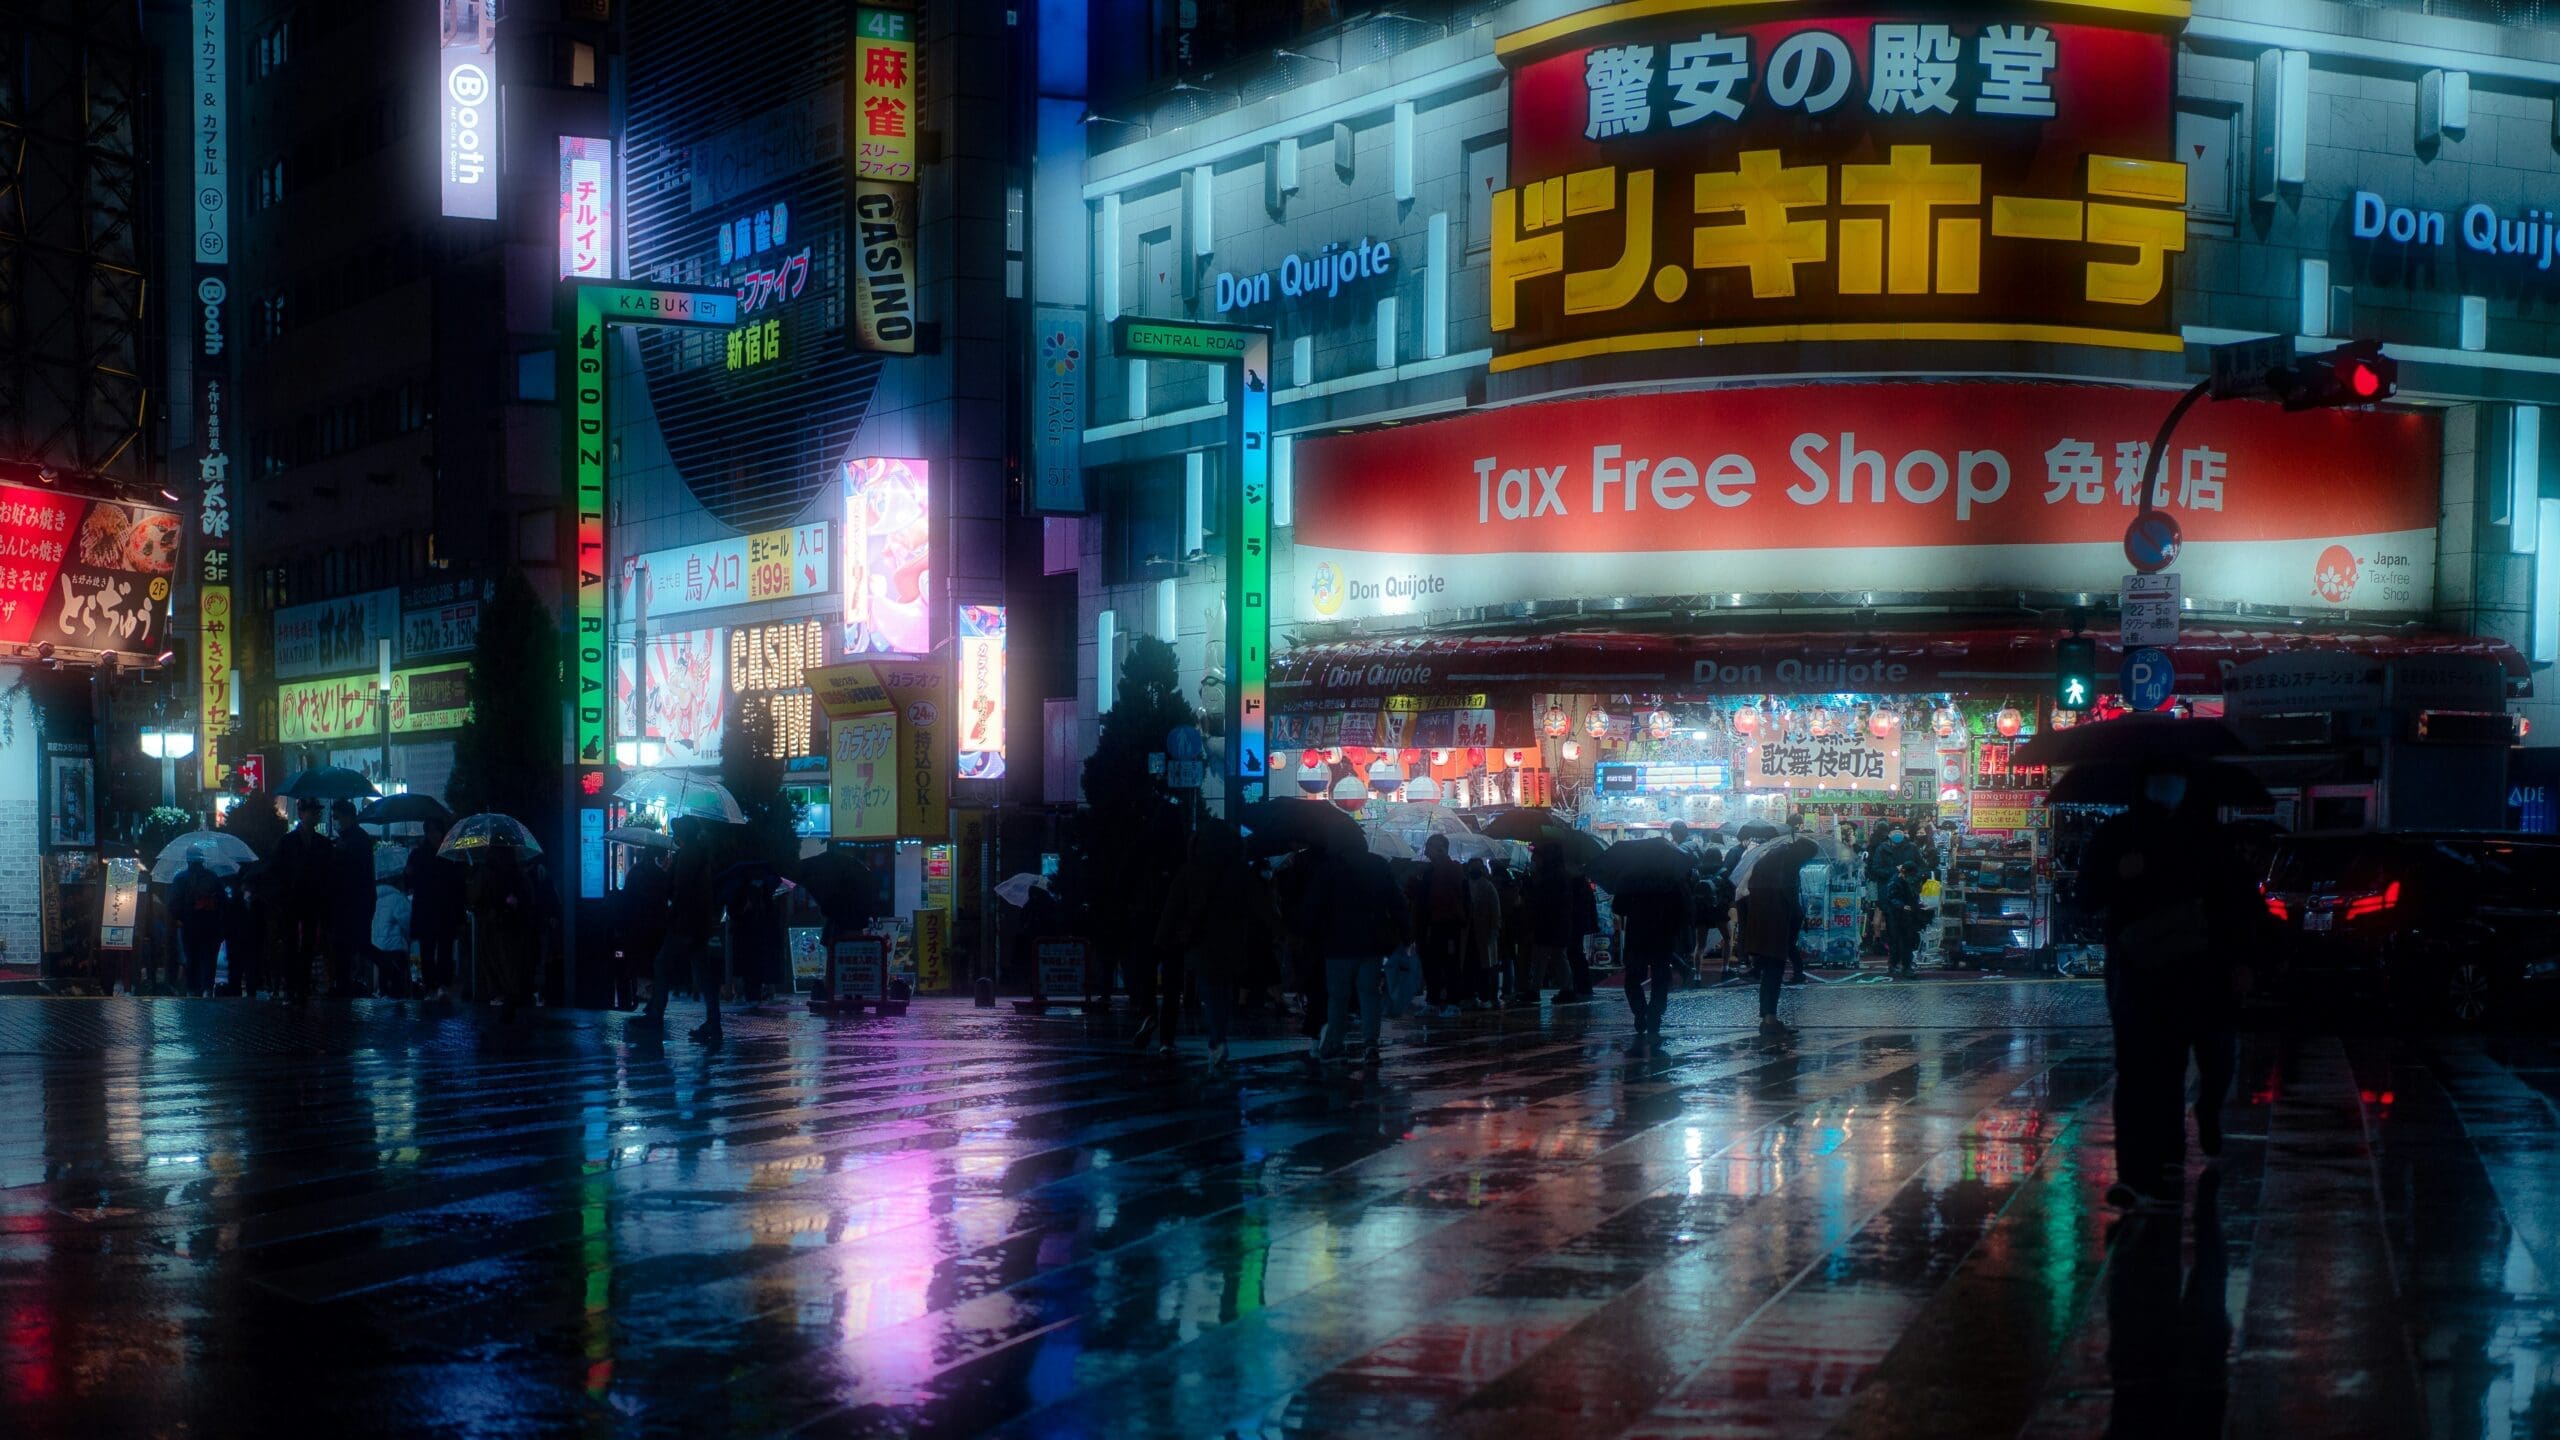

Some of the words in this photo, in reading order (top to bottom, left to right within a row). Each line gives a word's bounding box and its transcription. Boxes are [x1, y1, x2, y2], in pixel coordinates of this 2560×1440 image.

[868, 13, 904, 37] 4F
[864, 47, 908, 138] 麻雀
[1585, 24, 2057, 140] 驚安の殿堂
[449, 64, 489, 184] Booth
[203, 115, 218, 176] カプセル
[860, 144, 899, 157] スリー
[860, 160, 911, 176] ファイブ
[576, 181, 598, 273] チルイン
[2354, 191, 2445, 246] Don
[2463, 203, 2560, 270] Quij
[857, 194, 912, 341] CASINO
[1217, 271, 1270, 313] Don
[1280, 237, 1391, 298] Quijote
[198, 277, 227, 355] Booth
[727, 318, 781, 371] 新宿店
[1133, 329, 1201, 349] CENTRAL
[1206, 336, 1246, 351] ROAD
[1048, 381, 1061, 447] STAGE
[1063, 382, 1075, 432] IDOL
[580, 358, 602, 588] GODZILLA
[1473, 456, 1568, 524] Tax
[1592, 444, 1757, 515] Free
[1786, 432, 2012, 521] Shop
[2043, 438, 2228, 512] 免税店
[199, 452, 231, 539] 甘太郎
[0, 502, 66, 532] お好み焼き
[204, 550, 228, 565] 4F
[751, 534, 789, 563] 生ビール
[799, 529, 824, 556] 入口
[204, 566, 228, 581] 3F
[624, 560, 635, 579] 6F
[685, 552, 740, 601] 鳥メロ
[1245, 431, 1265, 714] ゴジラロード
[1350, 580, 1380, 600] Don
[1385, 574, 1445, 601] Quijote
[2130, 577, 2146, 589] 20
[2163, 577, 2171, 588] 7
[2368, 569, 2411, 585] Tax-free
[152, 583, 166, 596] 2F
[2382, 586, 2410, 603] Shop
[0, 598, 17, 622] ザ
[581, 616, 602, 724] ROAD
[731, 619, 823, 694] CASINO
[1328, 666, 1363, 688] Don
[1367, 662, 1432, 689] Quijote
[1693, 660, 1762, 685] Don
[1775, 658, 1908, 689] Quijote
[888, 671, 943, 688] カラオケ
[2131, 663, 2152, 701] P
[836, 723, 893, 762] カラオケ
[1761, 742, 1885, 779] 歌舞伎町店
[926, 913, 939, 968] カラオケ
